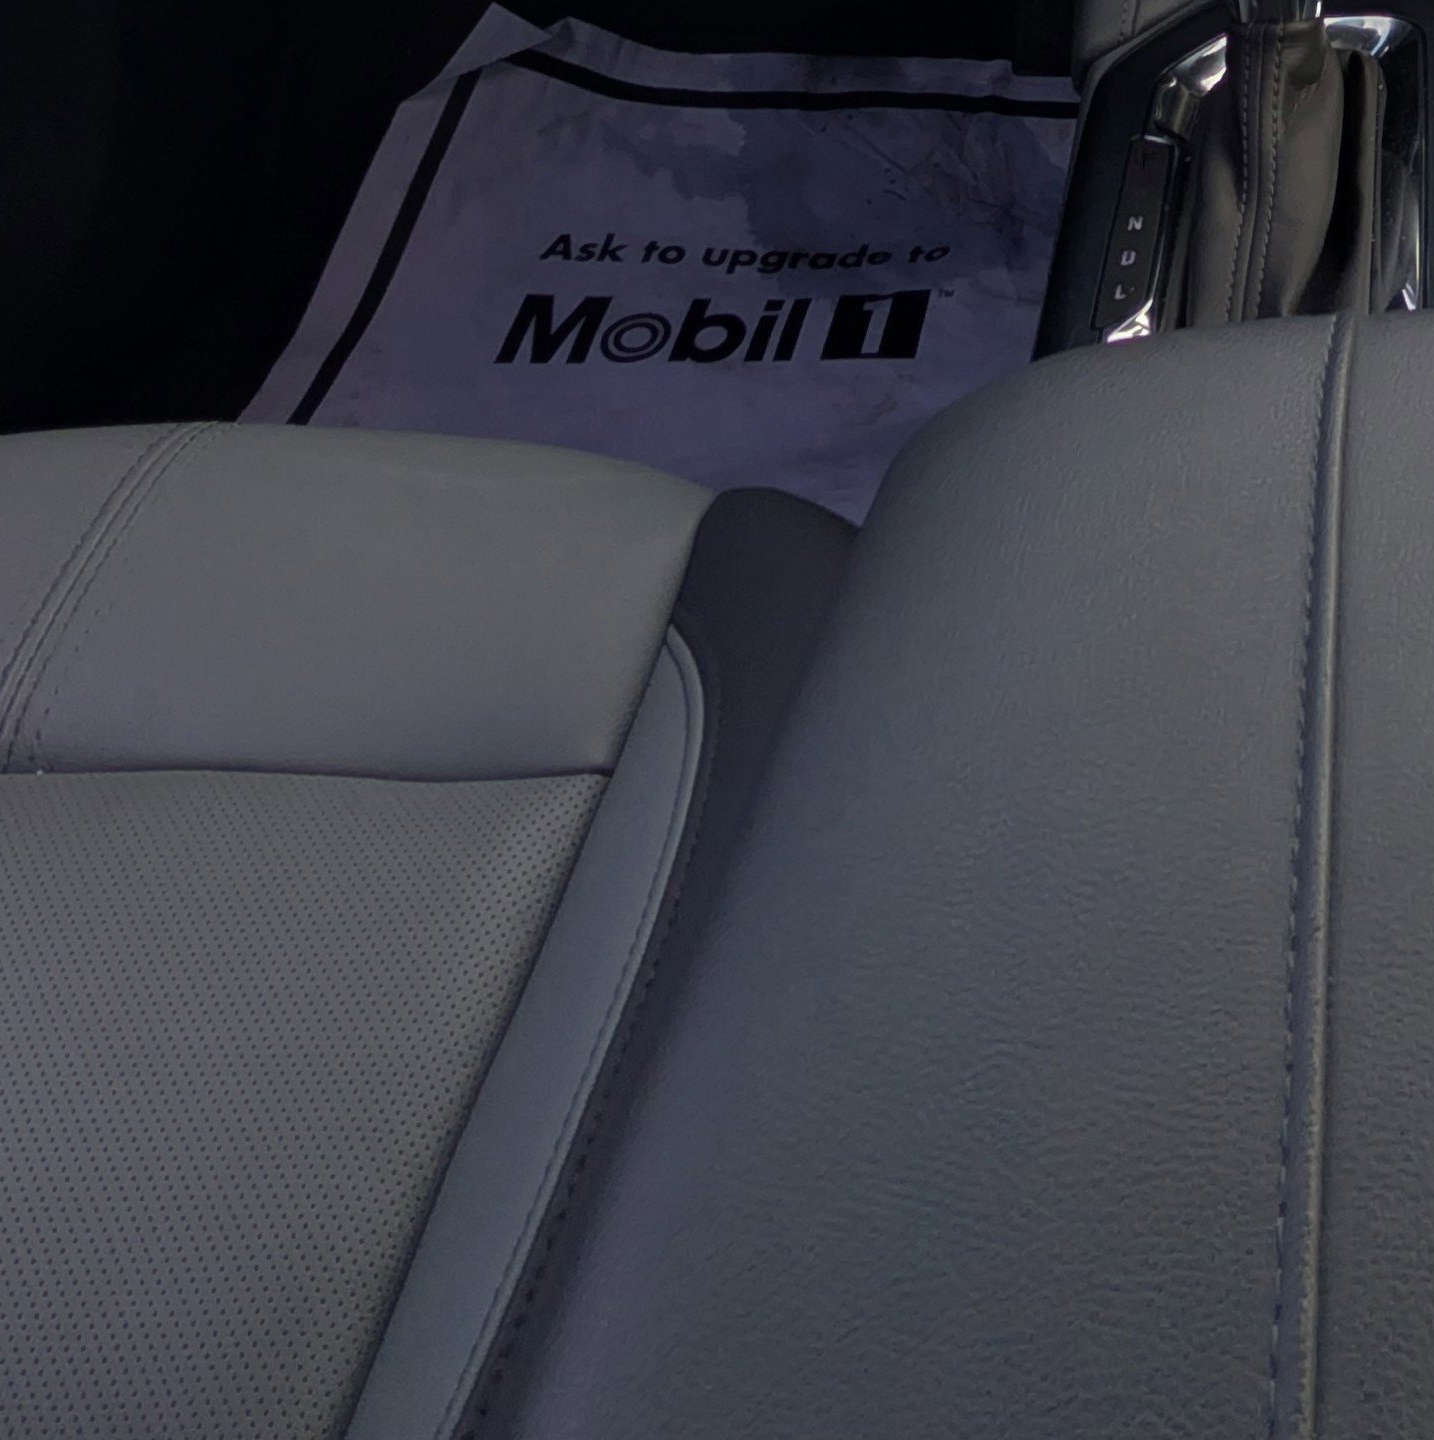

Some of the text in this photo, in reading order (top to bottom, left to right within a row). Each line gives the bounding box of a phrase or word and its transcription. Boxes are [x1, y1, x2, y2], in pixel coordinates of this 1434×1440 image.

[1127, 215, 1144, 232] N
[538, 233, 951, 276] Ask to upgrade to
[1120, 250, 1137, 267] D
[493, 292, 813, 365] Mobil
[819, 288, 933, 361] 1
